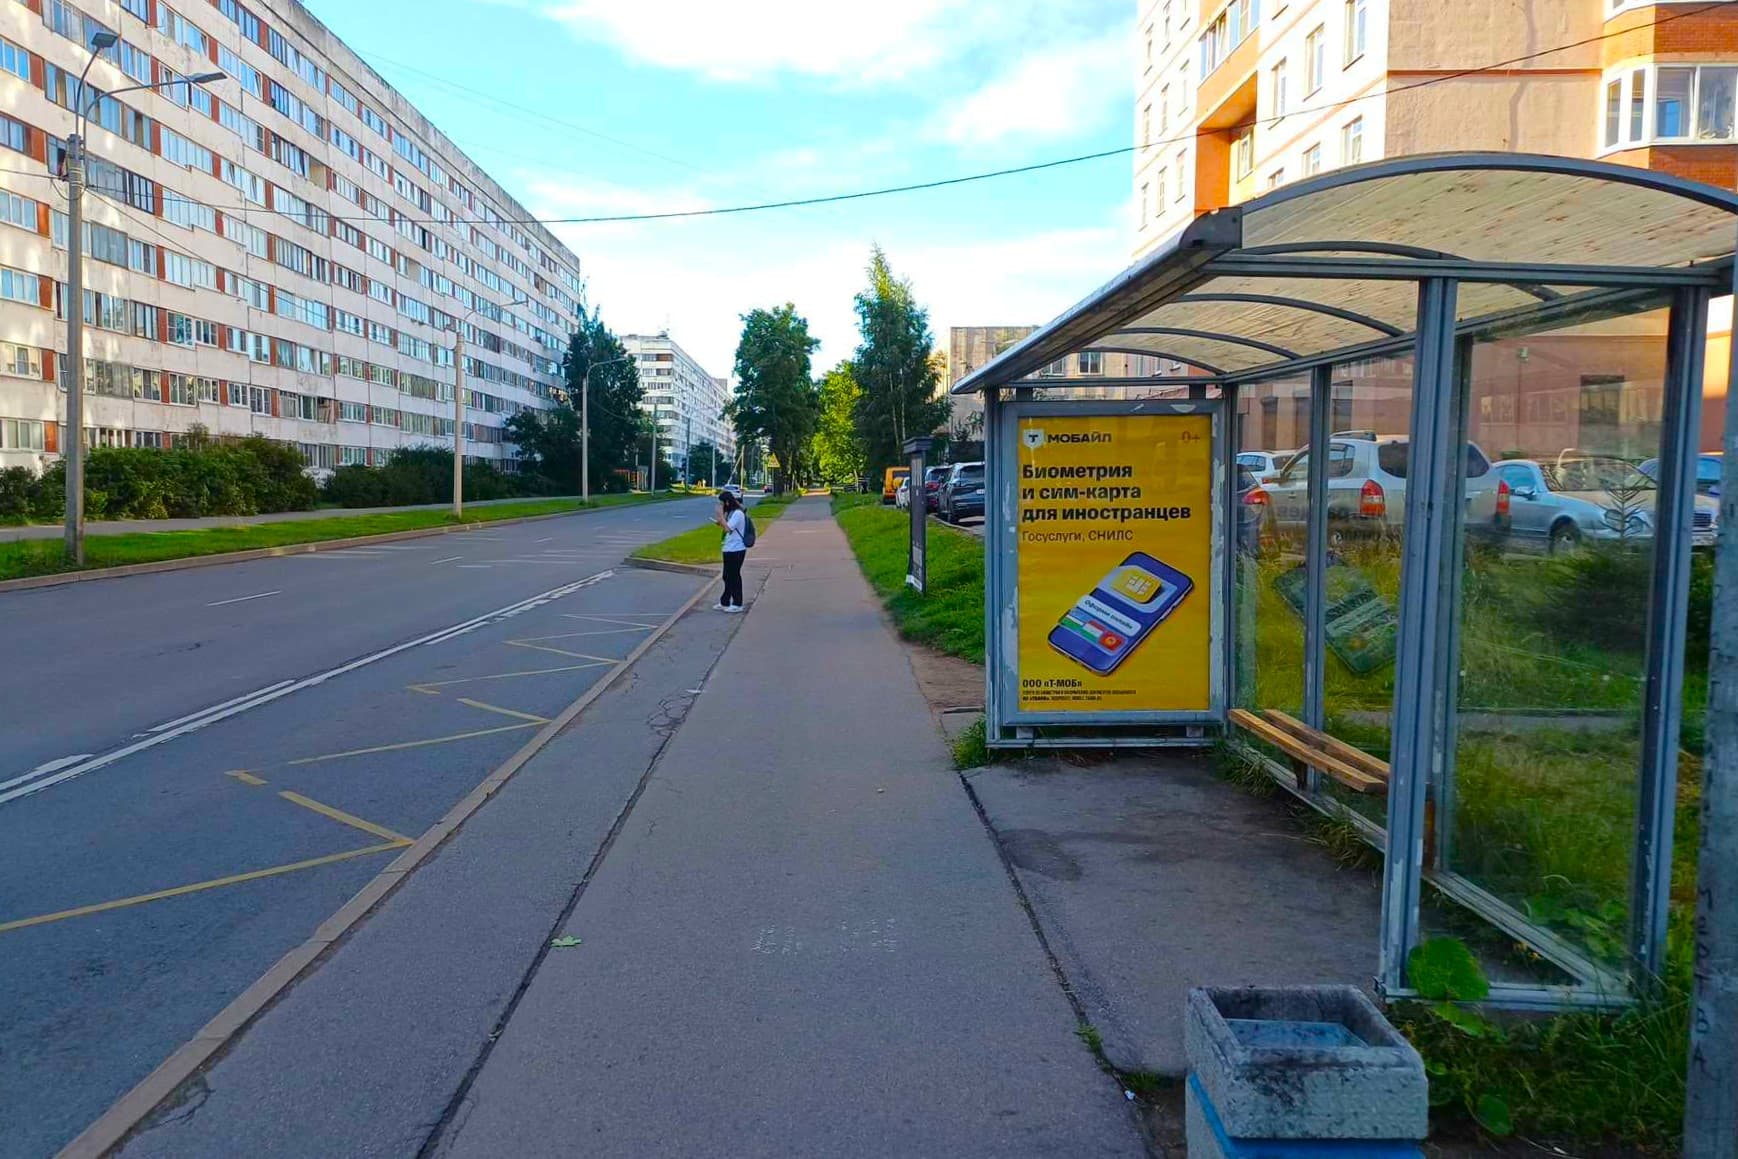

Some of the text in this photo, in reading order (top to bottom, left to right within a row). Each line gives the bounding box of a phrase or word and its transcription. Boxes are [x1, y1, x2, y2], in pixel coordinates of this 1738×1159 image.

[1047, 431, 1112, 443] МОБАЙЛ
[1182, 430, 1201, 444] 0+
[1022, 464, 1133, 481] Биометрия
[1022, 486, 1142, 502] и сим-карта
[1022, 506, 1191, 523] для иностранцев
[1022, 529, 1134, 543] Госуслуги, СНИЛС
[1022, 679, 1082, 689] ООО «Т-МОБ»
